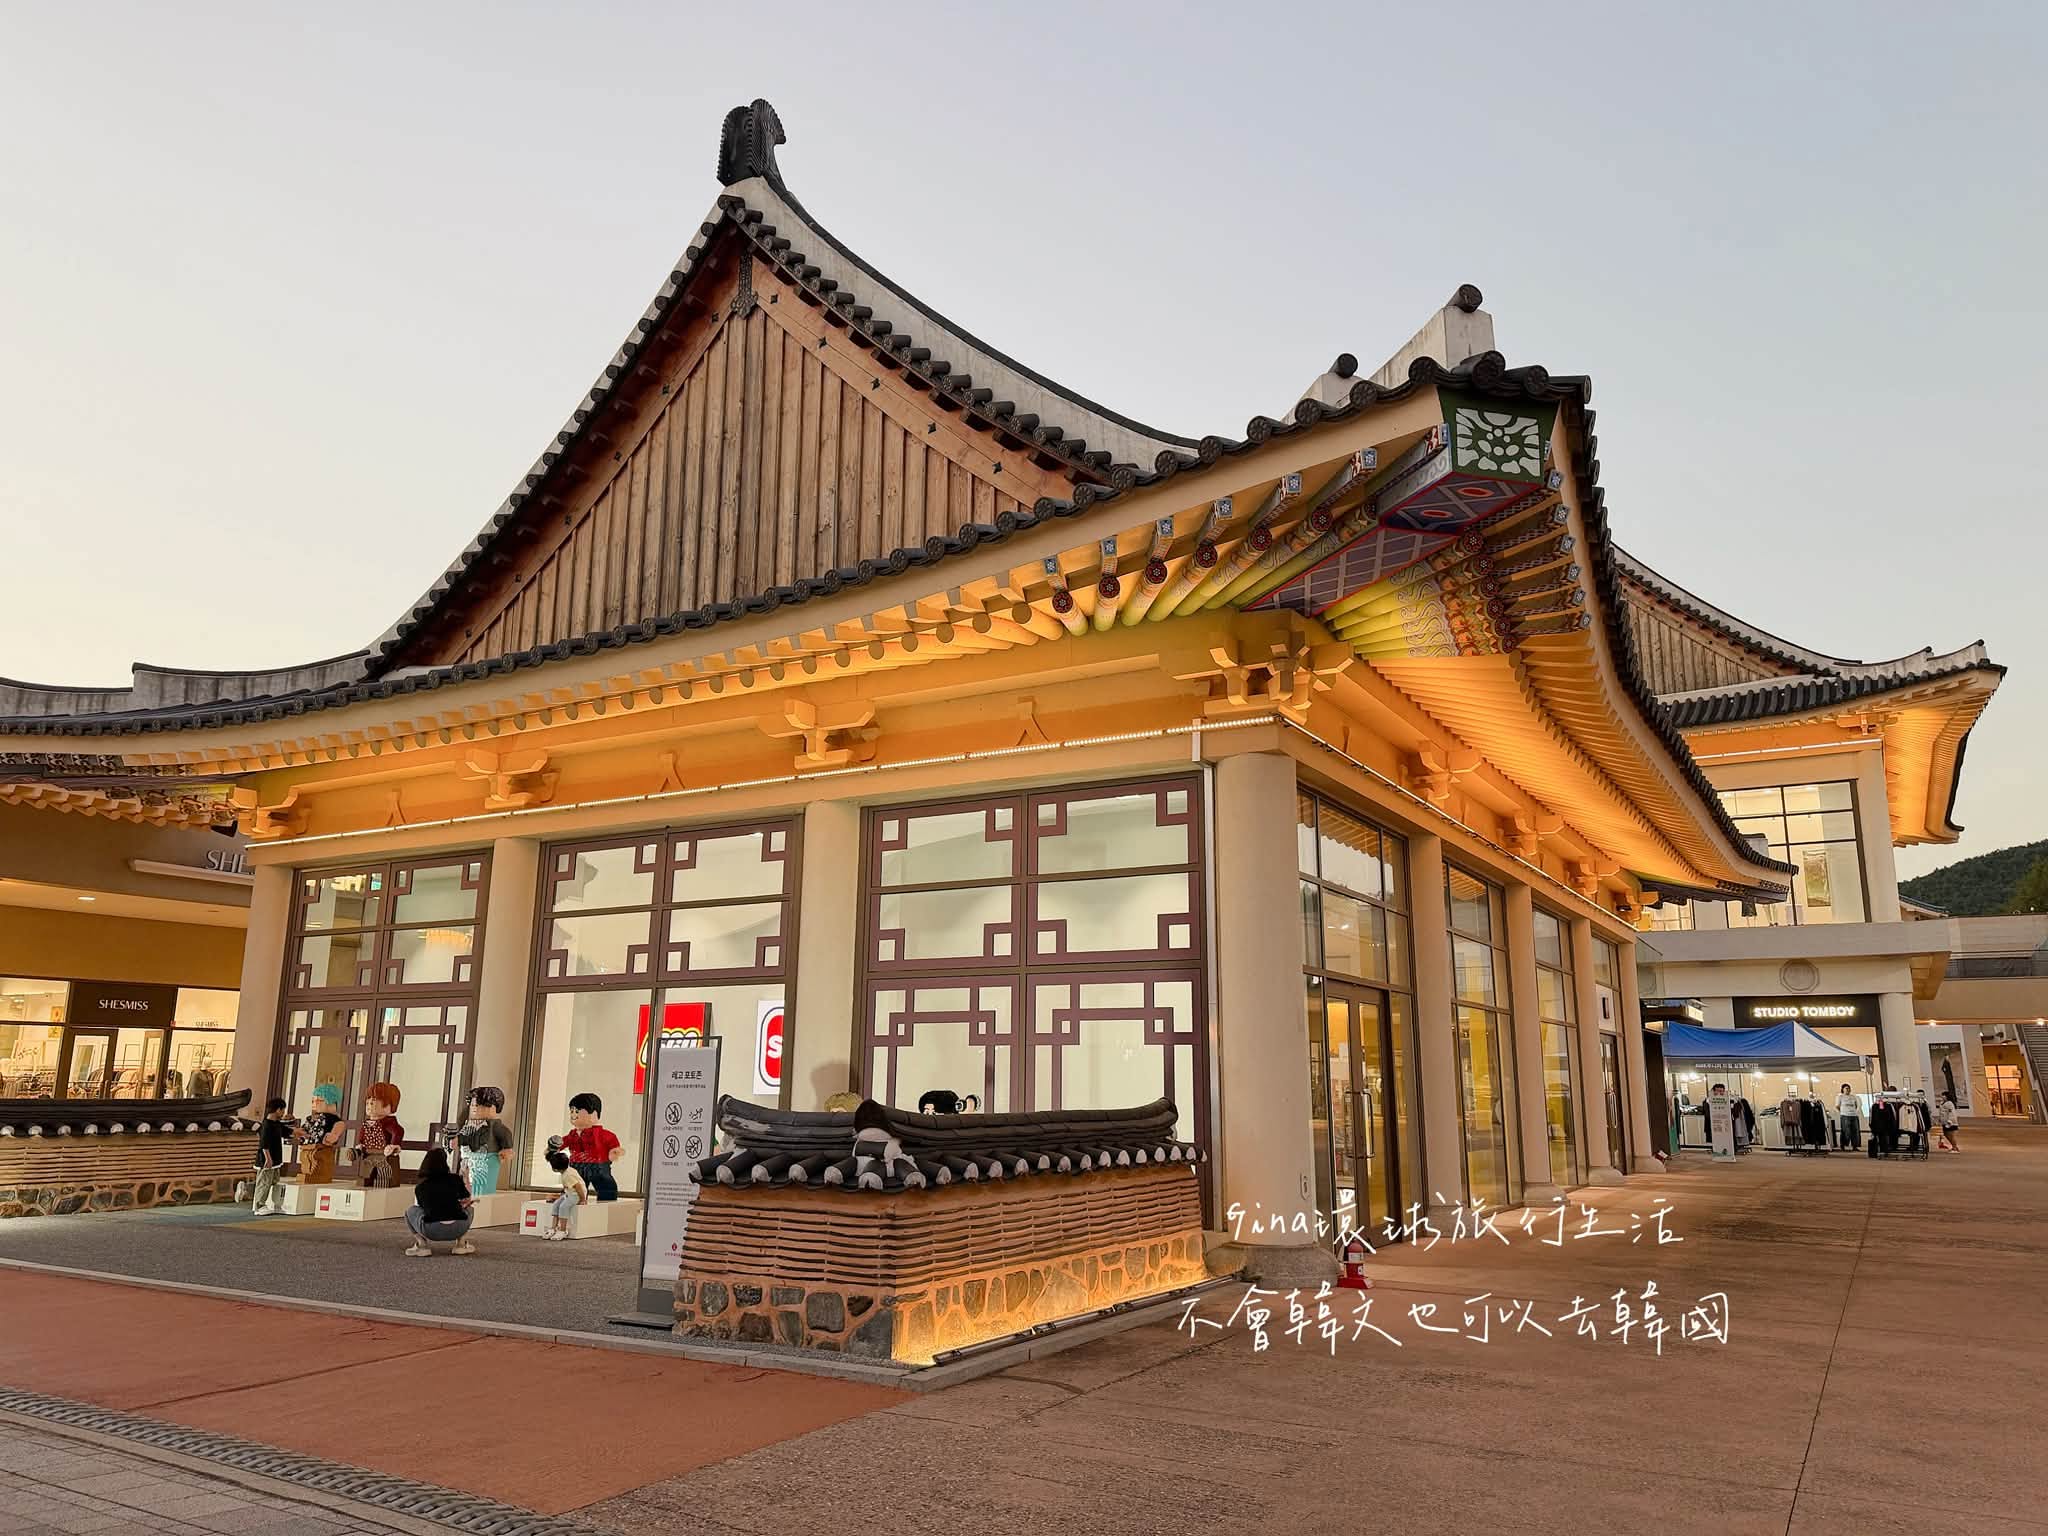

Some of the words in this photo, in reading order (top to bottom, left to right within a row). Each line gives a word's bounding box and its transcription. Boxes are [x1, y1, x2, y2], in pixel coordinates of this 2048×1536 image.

[98, 999, 149, 1011] SHESMISS
[1753, 1006, 1799, 1018] STUDIO
[1801, 1006, 1856, 1018] TOMBOY
[671, 1070, 684, 1080] 레고
[684, 1070, 703, 1080] 포토존
